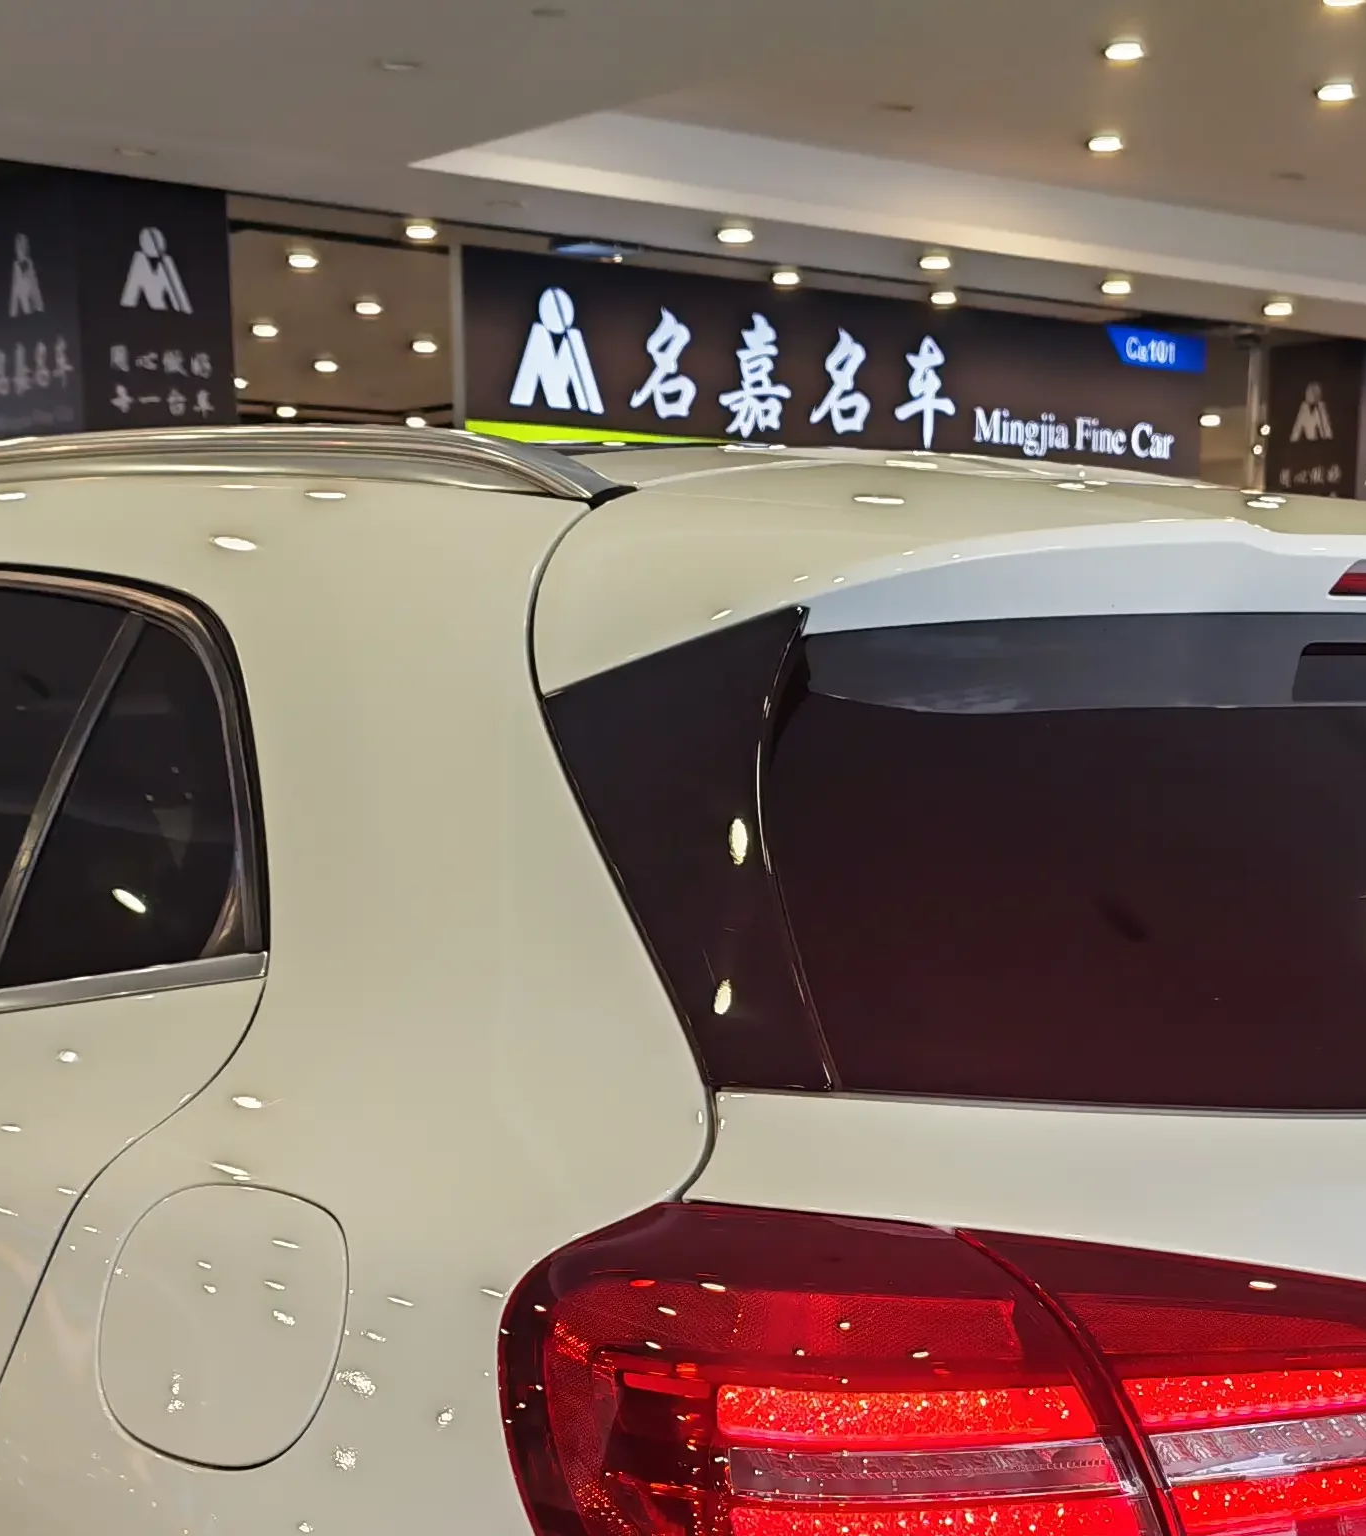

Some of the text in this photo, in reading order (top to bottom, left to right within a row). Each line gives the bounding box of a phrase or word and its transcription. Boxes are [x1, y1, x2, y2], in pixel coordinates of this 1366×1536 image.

[630, 306, 957, 449] 名嘉名车
[973, 406, 1176, 460] Mingjia Fine Car
